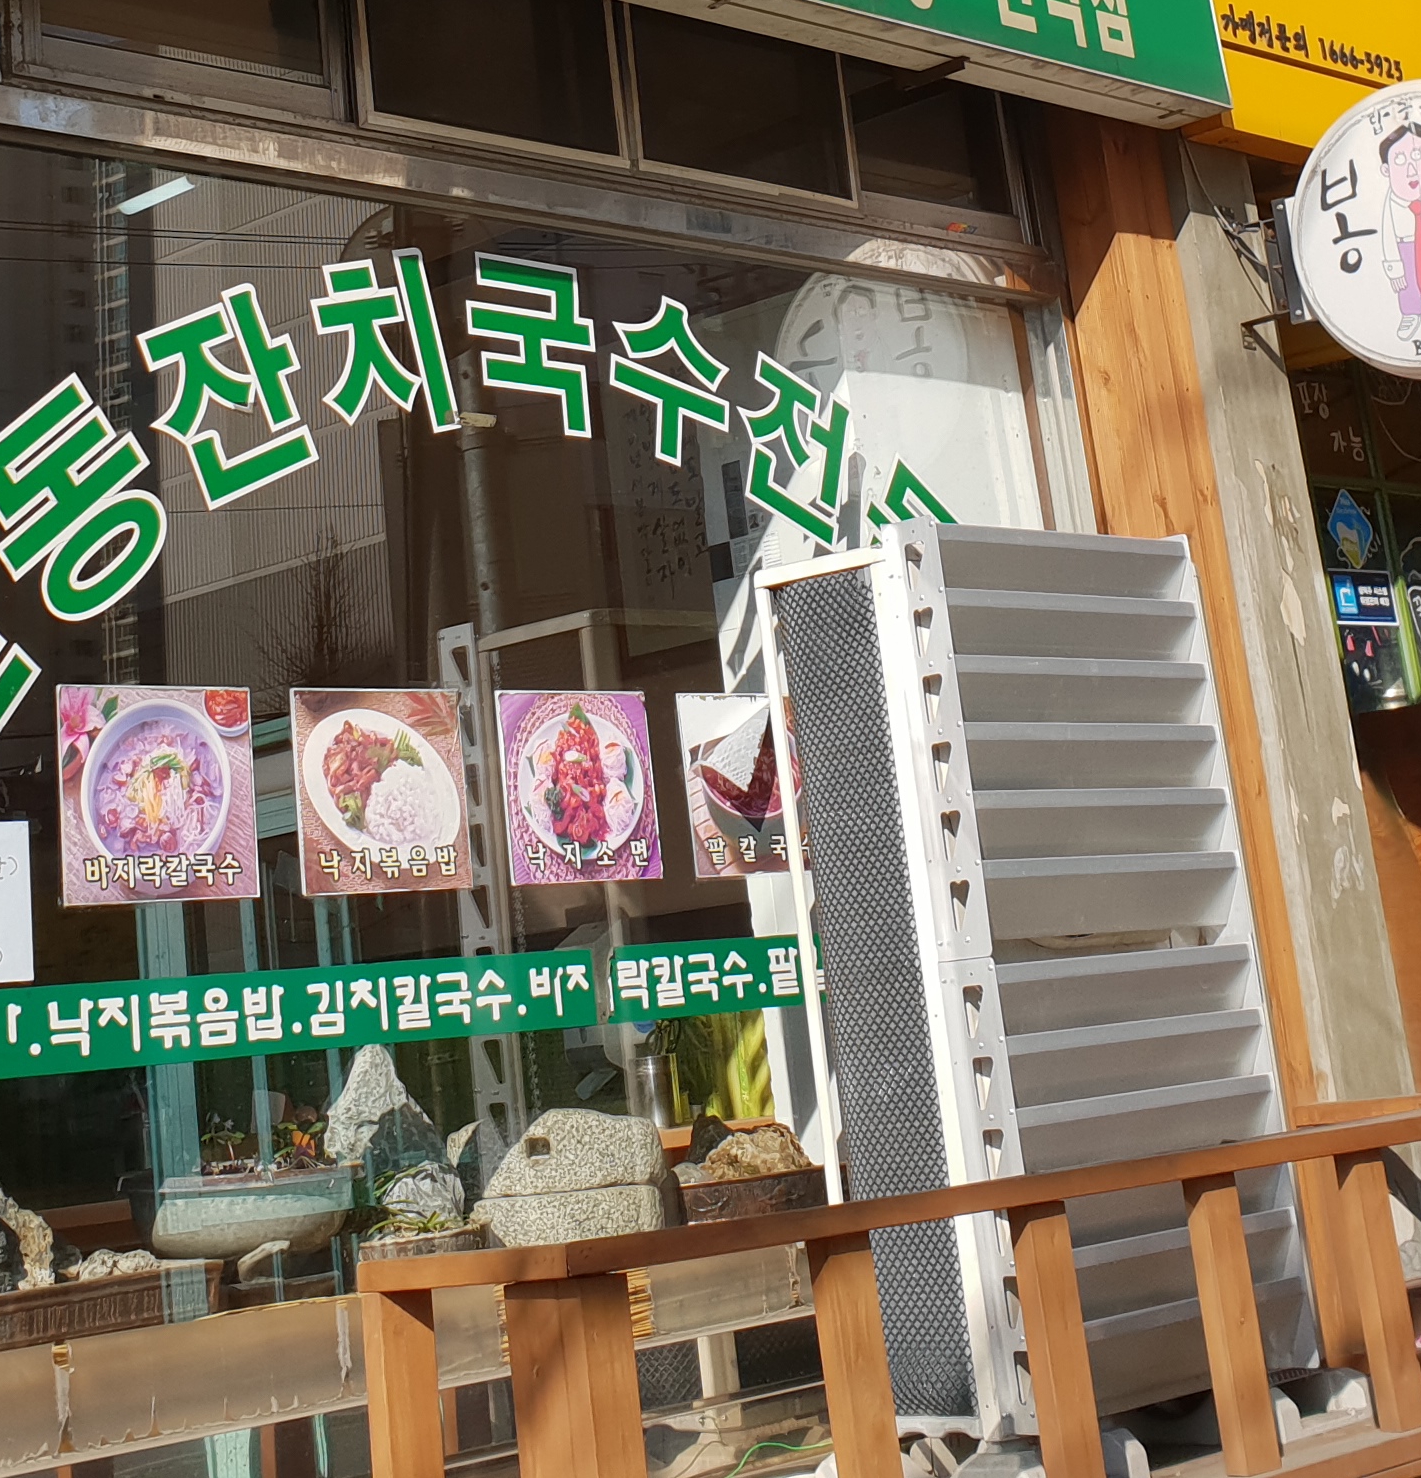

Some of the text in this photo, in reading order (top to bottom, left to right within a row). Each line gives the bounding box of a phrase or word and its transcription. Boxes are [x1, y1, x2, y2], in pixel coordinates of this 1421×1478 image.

[1318, 37, 1404, 83] 1666-5925
[1320, 158, 1378, 274] 봉
[84, 852, 243, 890] 바지락칼국수
[318, 845, 458, 882] 낙지볶음밥
[526, 839, 650, 872] 낙지소면
